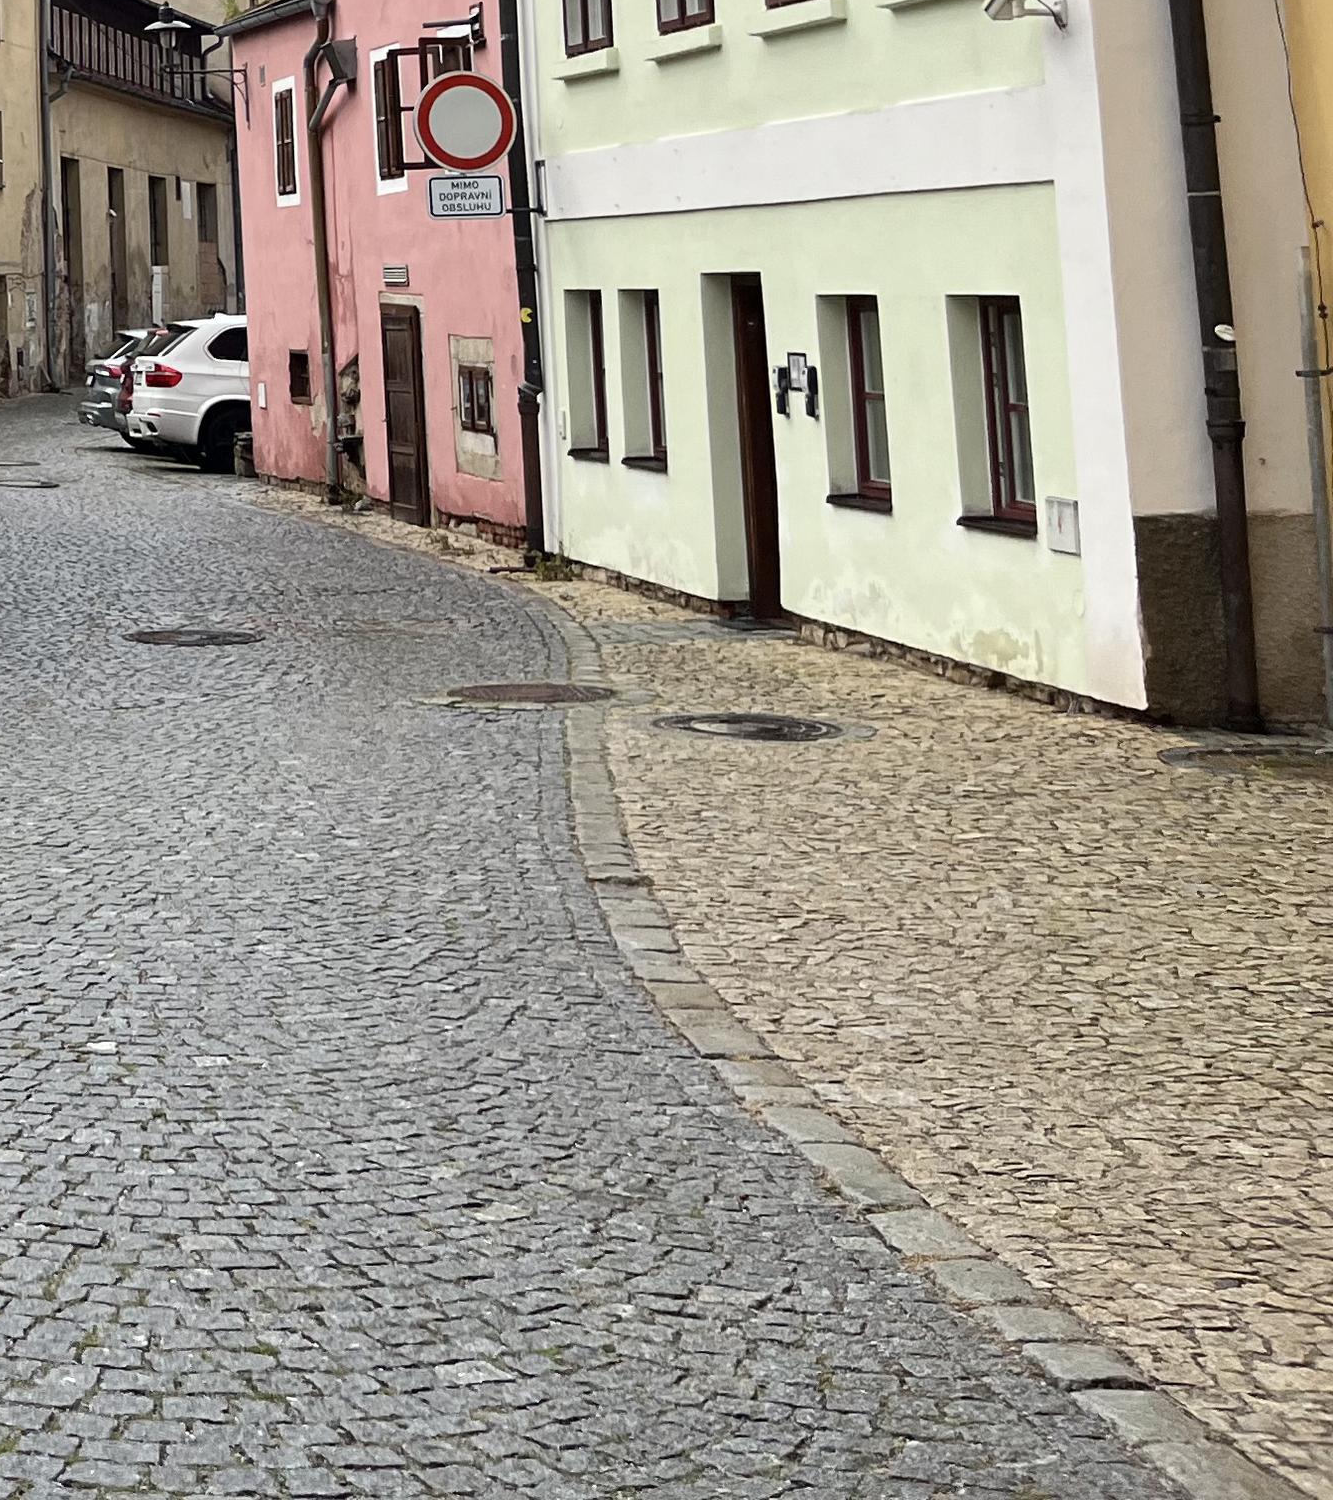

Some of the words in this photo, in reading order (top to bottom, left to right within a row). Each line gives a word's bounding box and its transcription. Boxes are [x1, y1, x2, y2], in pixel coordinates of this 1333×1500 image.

[451, 180, 479, 190] MIMO
[439, 190, 492, 202] DOPRAVNÍ
[441, 202, 492, 212] OBSLUHU
